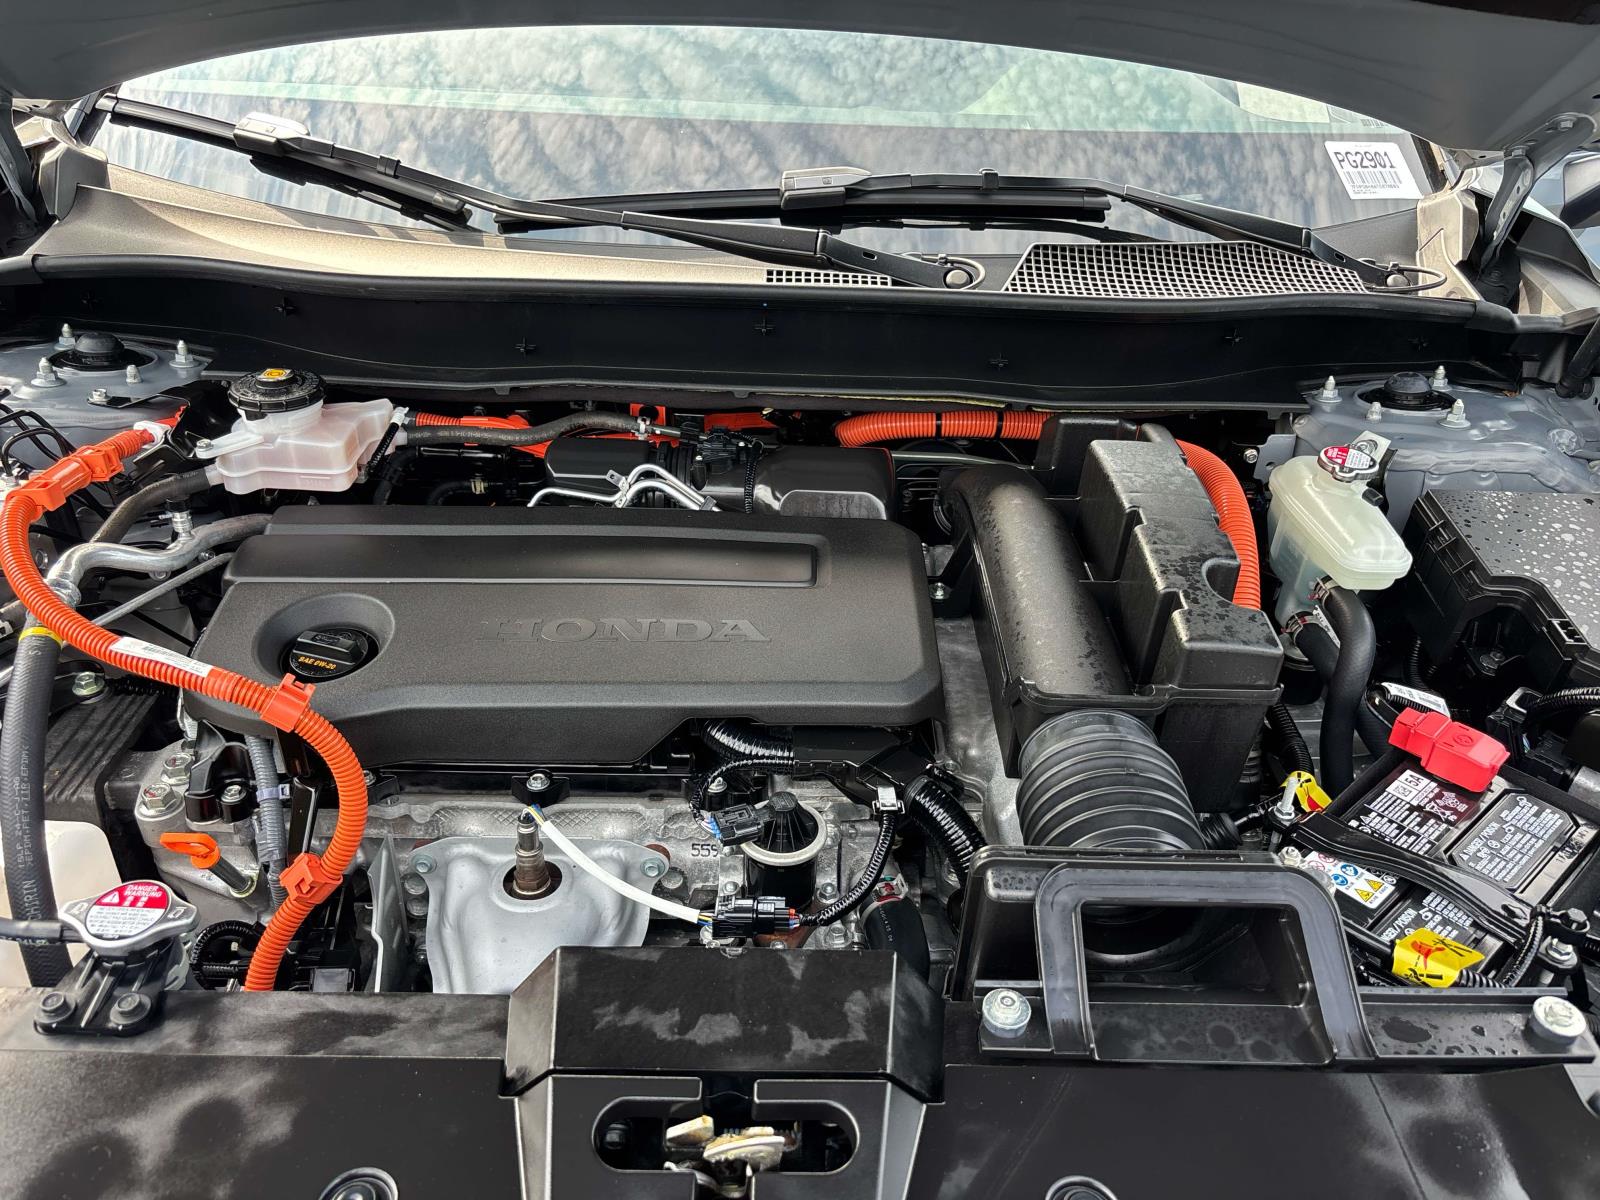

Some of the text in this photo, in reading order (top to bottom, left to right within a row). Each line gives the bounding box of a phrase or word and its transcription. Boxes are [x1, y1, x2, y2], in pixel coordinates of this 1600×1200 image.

[1334, 151, 1396, 169] PG2901
[475, 616, 772, 643] HONDA
[298, 655, 337, 670] SAE 0W-20
[1404, 774, 1425, 787] 5A
[126, 884, 159, 892] DANGER
